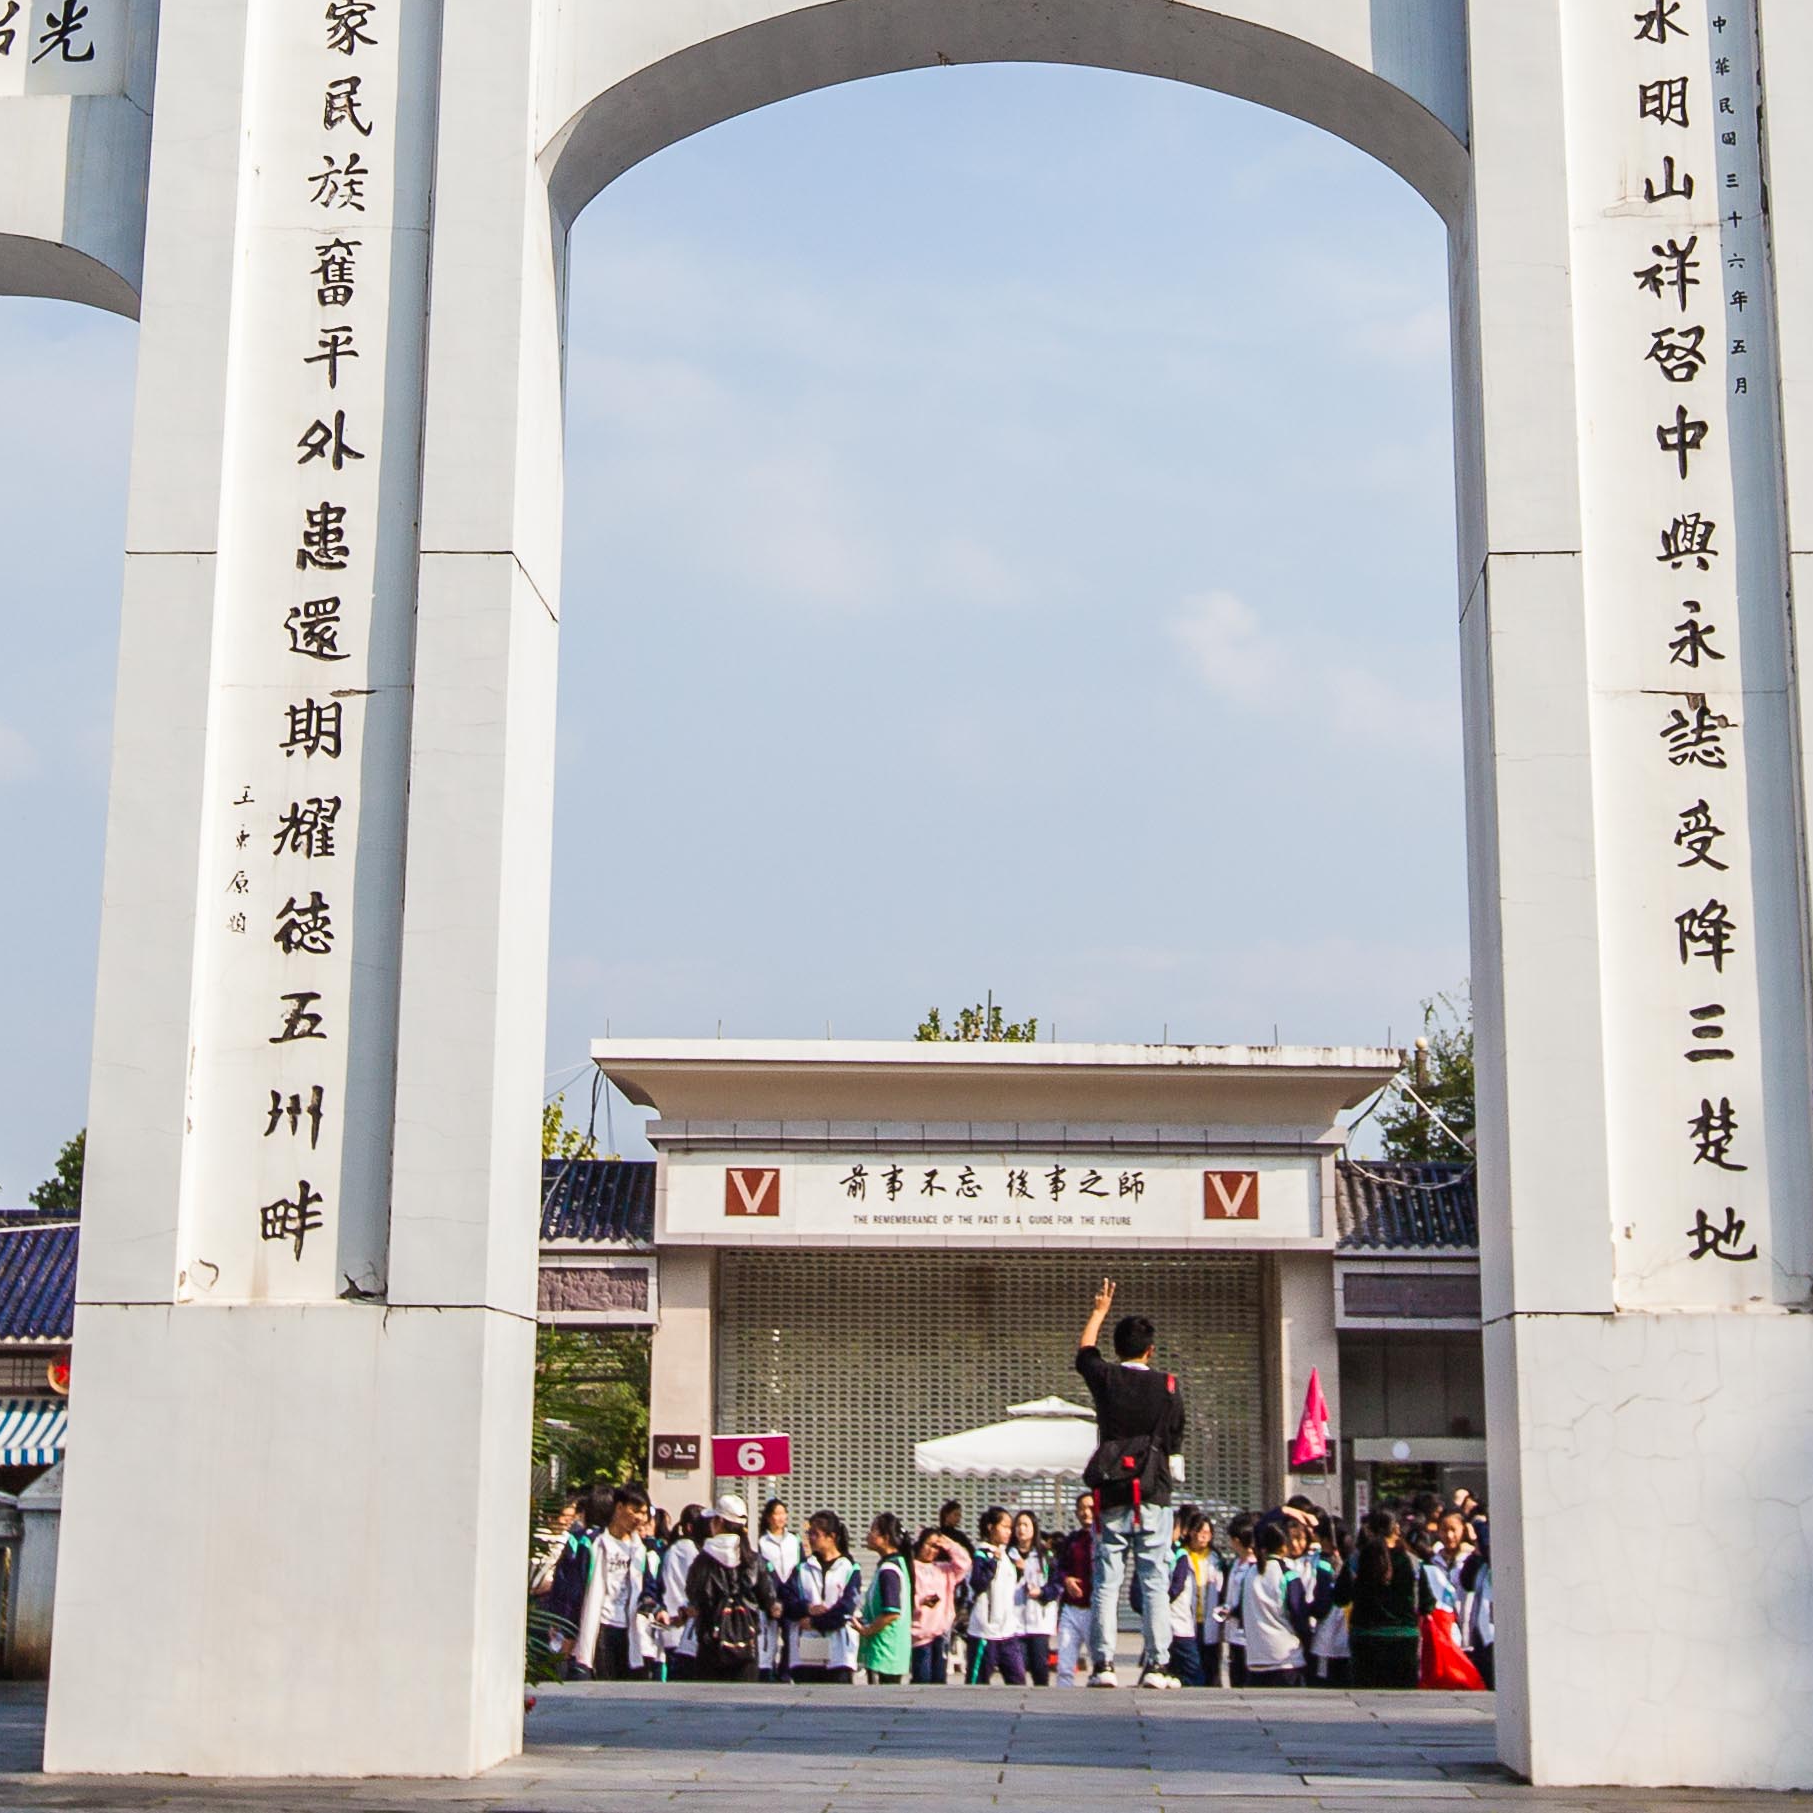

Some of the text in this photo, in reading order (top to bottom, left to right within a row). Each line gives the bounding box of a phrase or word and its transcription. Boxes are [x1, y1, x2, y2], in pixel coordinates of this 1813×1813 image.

[839, 1163, 1145, 1203] 前事不忘 後事之師
[853, 1214, 868, 1225] THE
[942, 1214, 953, 1225] OF
[959, 1214, 973, 1225] THE
[978, 1214, 999, 1225] PAST
[1003, 1214, 1011, 1225] IS
[1028, 1215, 1053, 1226] GUIDE
[1057, 1215, 1073, 1226] FOR
[1081, 1215, 1095, 1226] THE
[1100, 1215, 1132, 1226] FUTURE
[737, 1442, 766, 1472] 6
